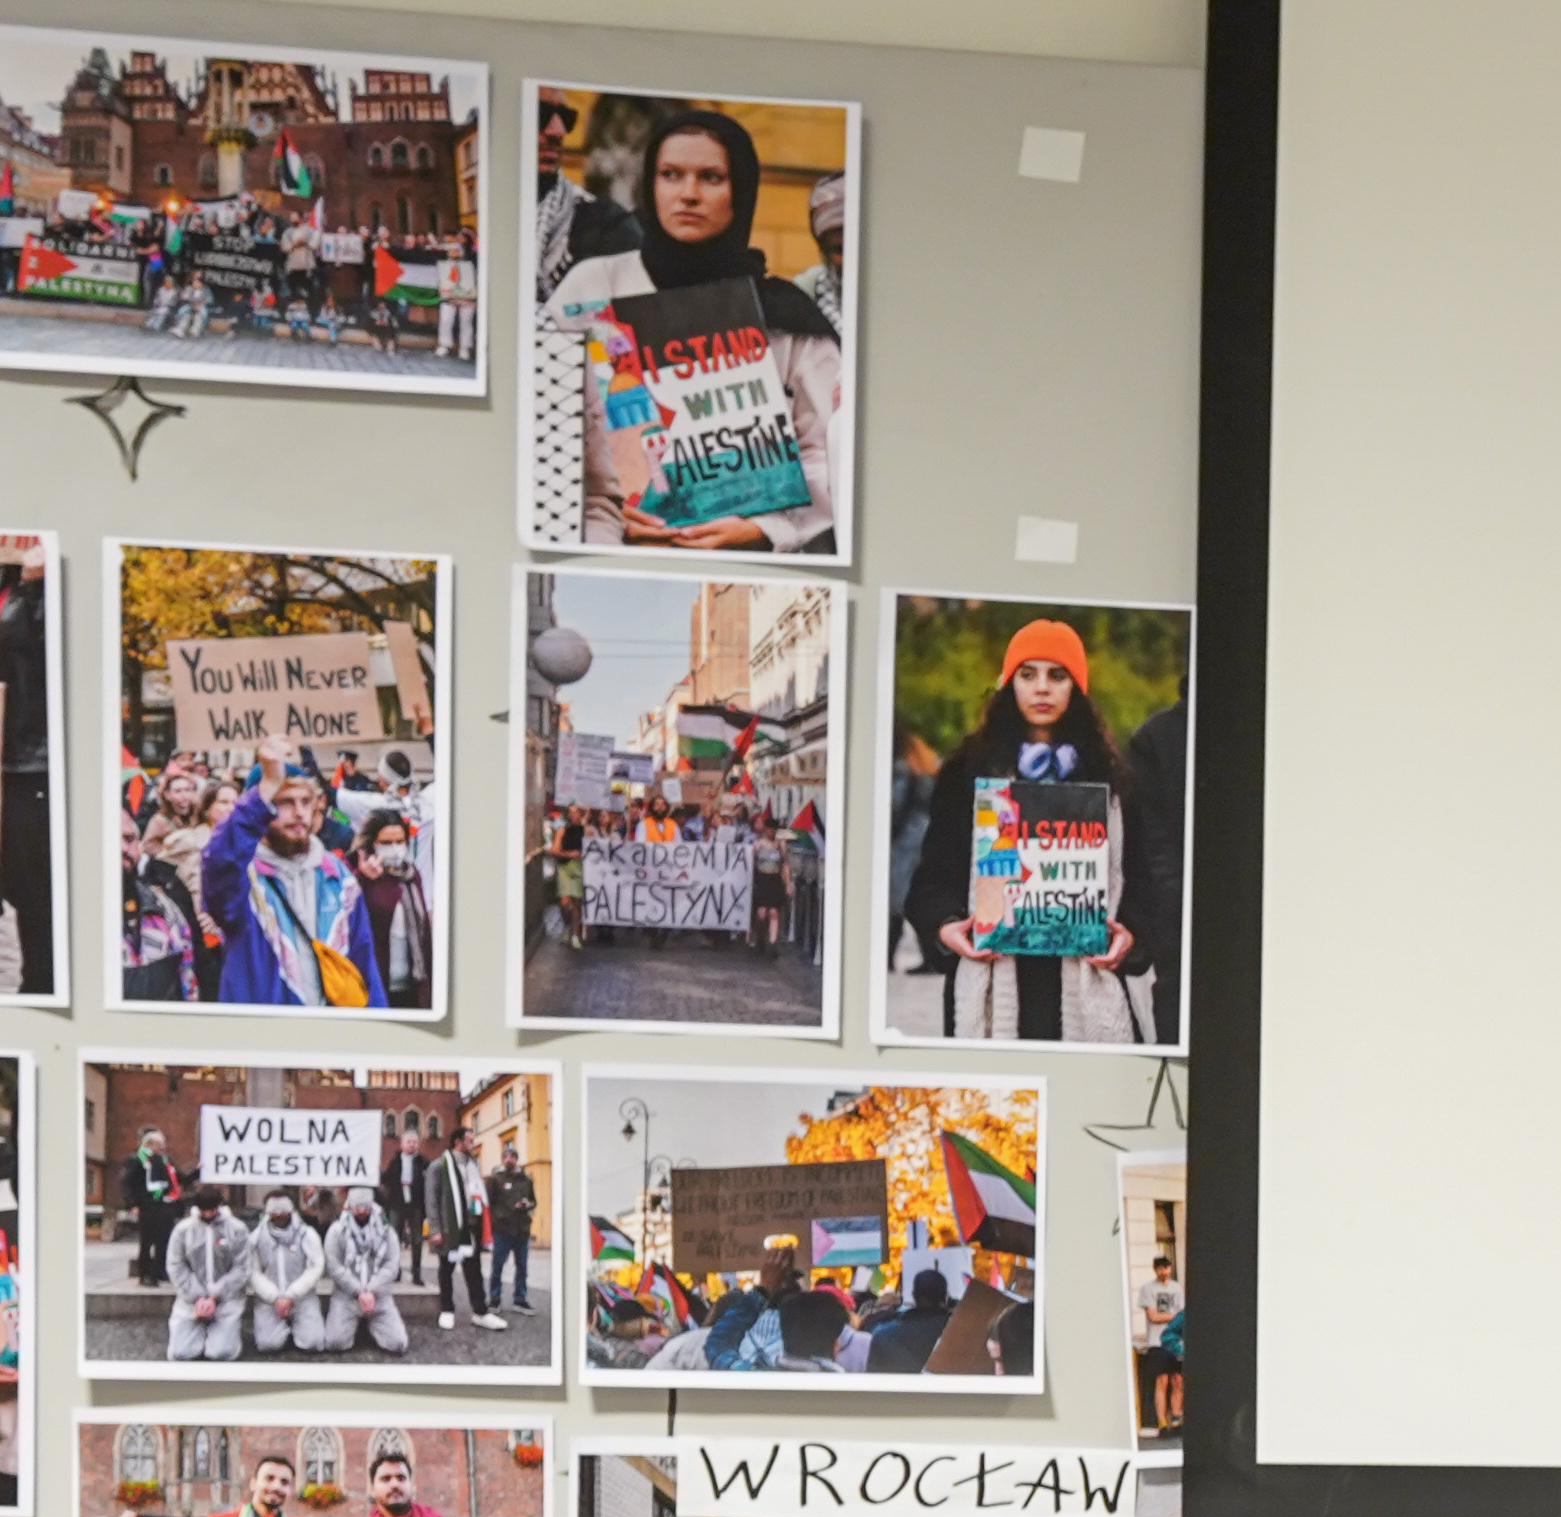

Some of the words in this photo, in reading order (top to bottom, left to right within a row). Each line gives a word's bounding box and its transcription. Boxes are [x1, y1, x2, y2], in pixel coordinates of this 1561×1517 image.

[642, 345, 660, 384] I
[663, 326, 767, 380] STAND
[682, 378, 768, 421] WITH
[180, 647, 233, 694] YOU
[284, 656, 367, 690] NEVER
[285, 702, 359, 737] ALONE
[1021, 821, 1029, 849] I
[1035, 819, 1106, 849] STAND
[1039, 860, 1097, 881] WITH
[217, 1114, 350, 1144] WOLNA
[214, 1154, 368, 1177] PALESTYNA
[700, 1443, 1130, 1514] WROCŁAW
